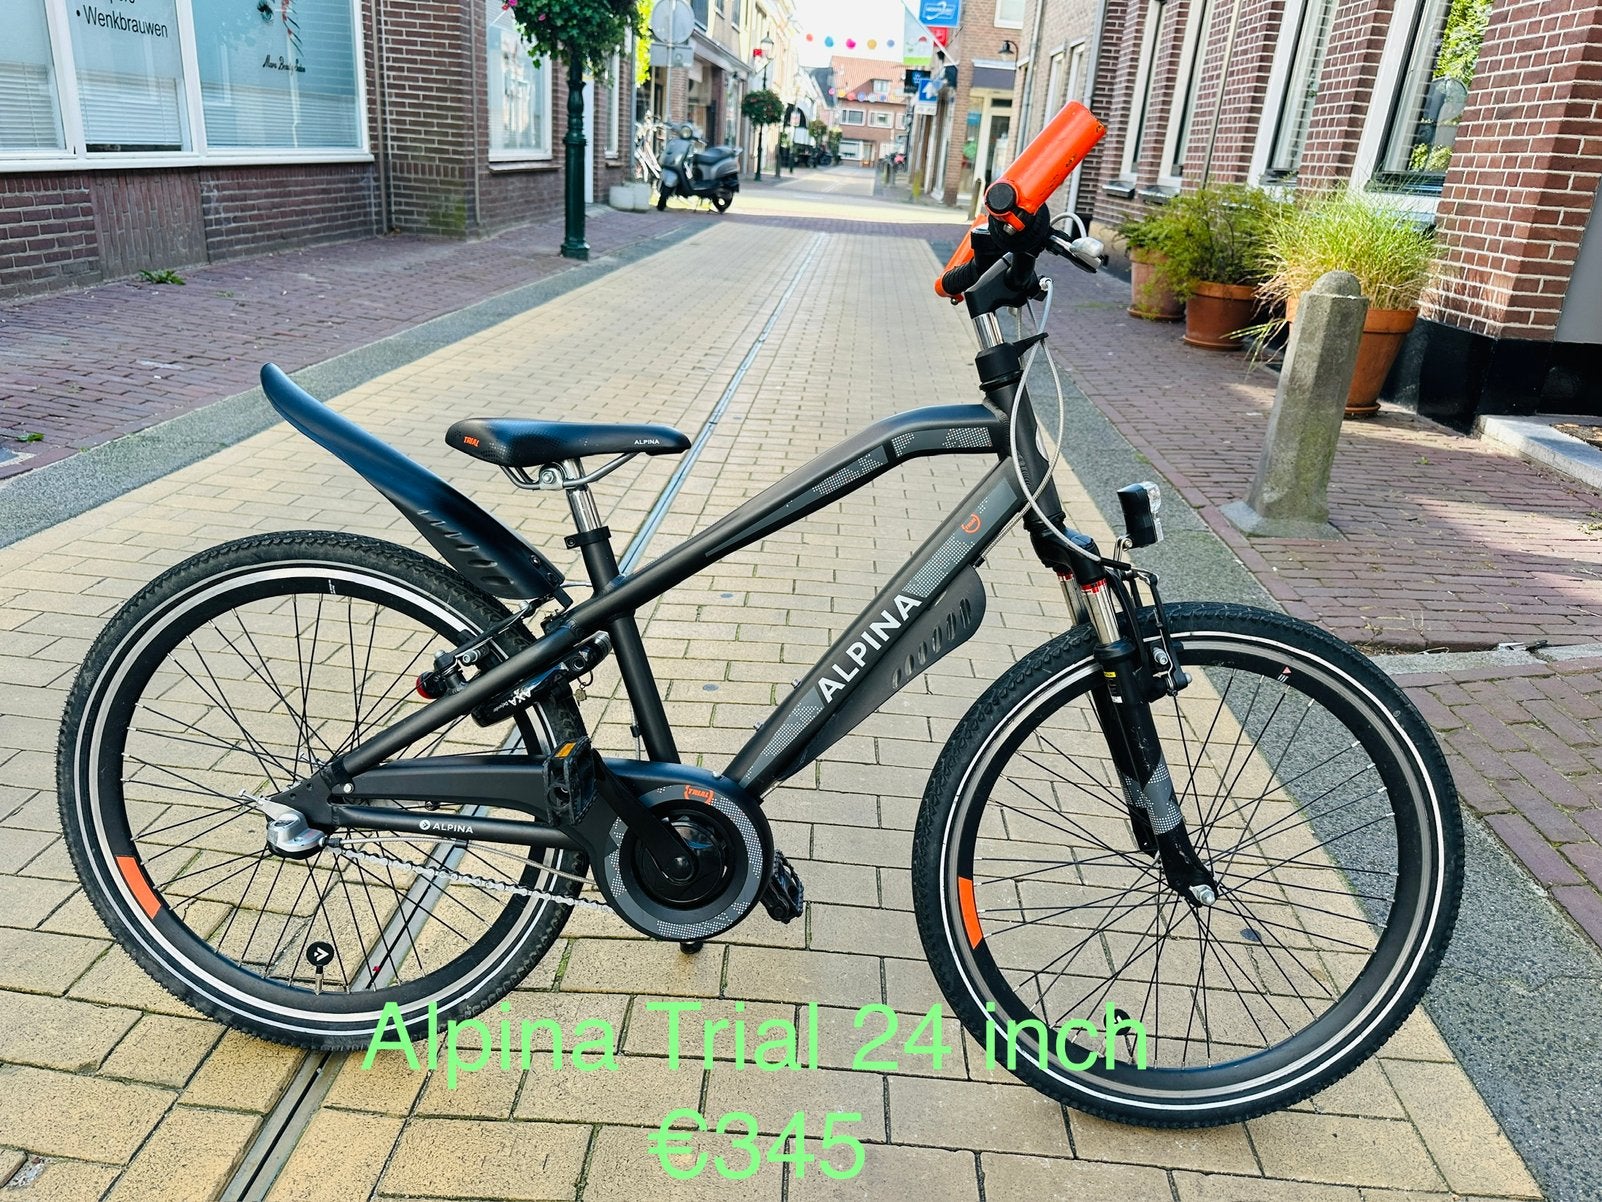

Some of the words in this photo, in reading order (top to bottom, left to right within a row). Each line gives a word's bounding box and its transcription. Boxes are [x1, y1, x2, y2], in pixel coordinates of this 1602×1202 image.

[83, 4, 168, 38] Wenkbrauwen
[463, 436, 480, 447] TRIAL
[818, 594, 922, 703] ALPINA
[508, 687, 531, 706] AXA
[432, 822, 474, 834] ALPINA
